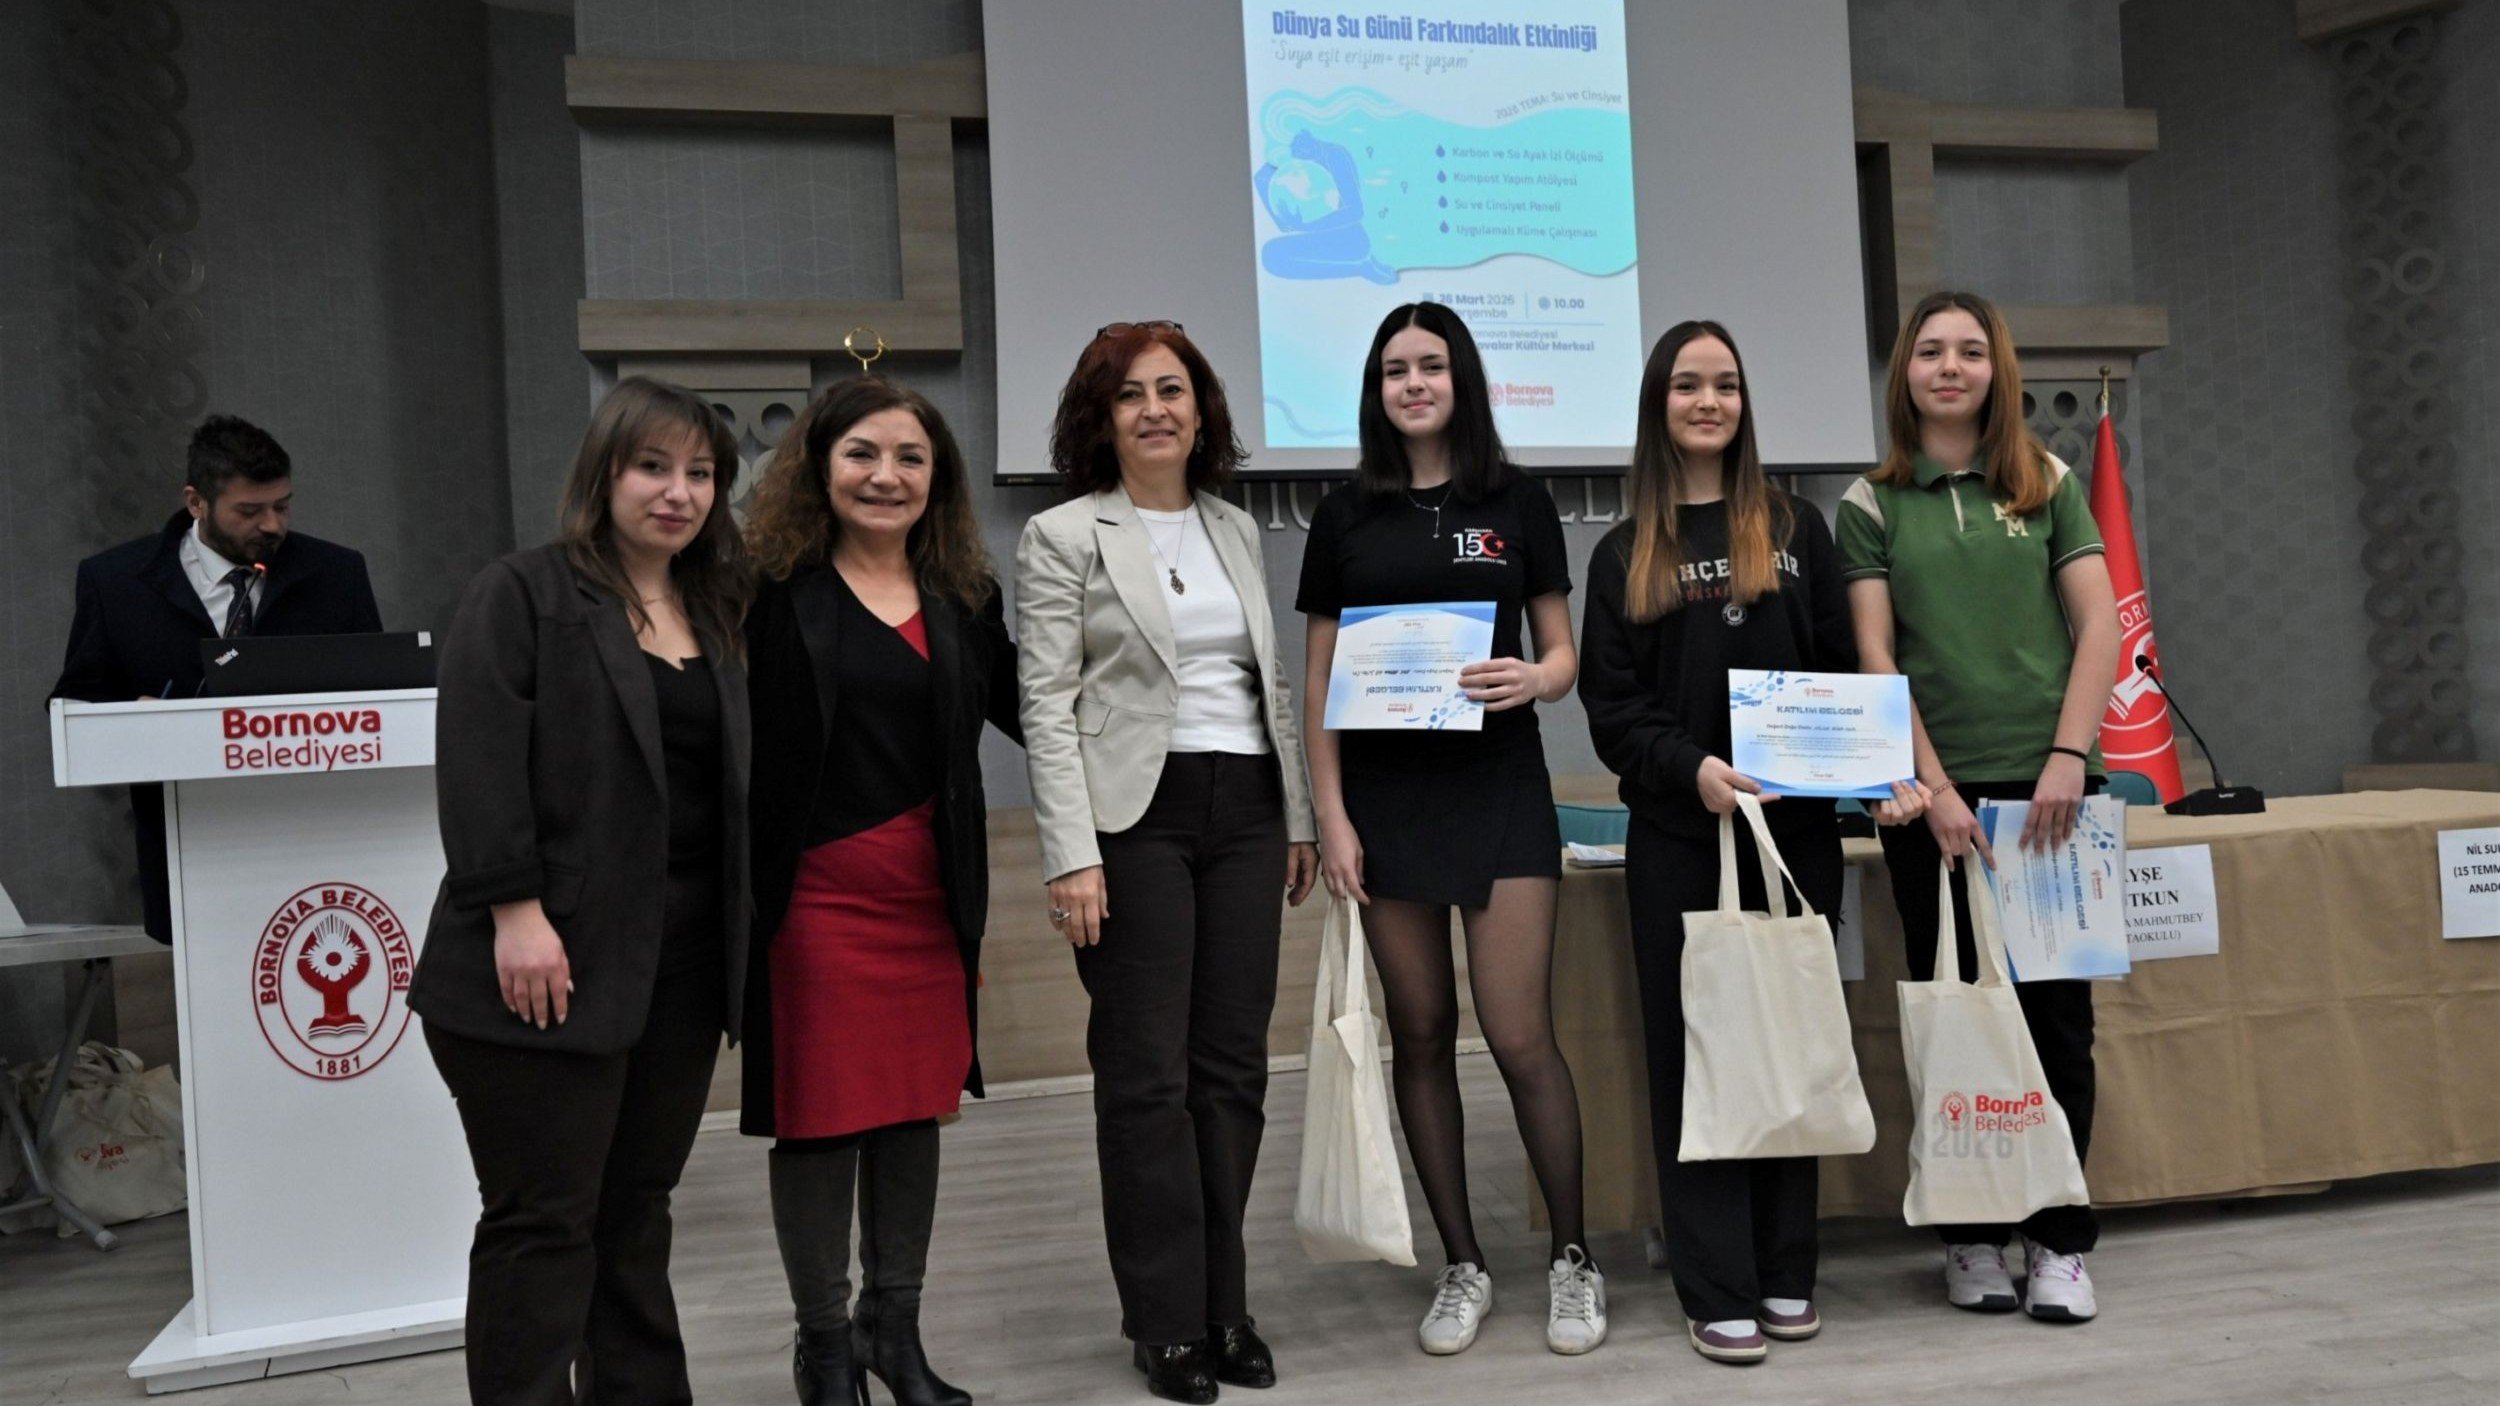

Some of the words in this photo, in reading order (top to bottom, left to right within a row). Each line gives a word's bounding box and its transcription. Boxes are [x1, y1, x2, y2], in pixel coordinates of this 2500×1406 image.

[1272, 10, 1331, 39] Dünya
[1336, 14, 1360, 38] Su
[1365, 14, 1413, 41] Günü
[1417, 18, 1521, 46] Farkındalık
[1525, 24, 1597, 52] Etkinliği
[1452, 147, 1490, 159] Karbon
[1493, 150, 1505, 160] ve
[1453, 172, 1499, 187] Kompost
[1455, 199, 1468, 210] Su
[1471, 201, 1483, 210] ve
[1455, 293, 1485, 304] Mart
[1554, 298, 1585, 310] 10.00
[1457, 308, 1508, 321] erşembe
[1515, 339, 1549, 351] Kültür
[1552, 342, 1595, 351] Merkezi
[1505, 383, 1554, 395] Bornova
[1777, 705, 1818, 715] KATILIM
[222, 708, 381, 740] Bornova
[224, 736, 382, 771] Belediyesi
[2466, 843, 2483, 855] NİL
[2484, 843, 2500, 854] SU
[2126, 866, 2163, 884] YŞE
[2453, 865, 2470, 879] (15
[2469, 882, 2500, 894] ANAD
[2128, 889, 2179, 907] TKUN
[2133, 911, 2204, 927] MAHMUTBEY
[2126, 930, 2182, 944] TAOKULU)
[259, 899, 315, 1006] BORNOVA
[316, 1055, 361, 1075] 1881
